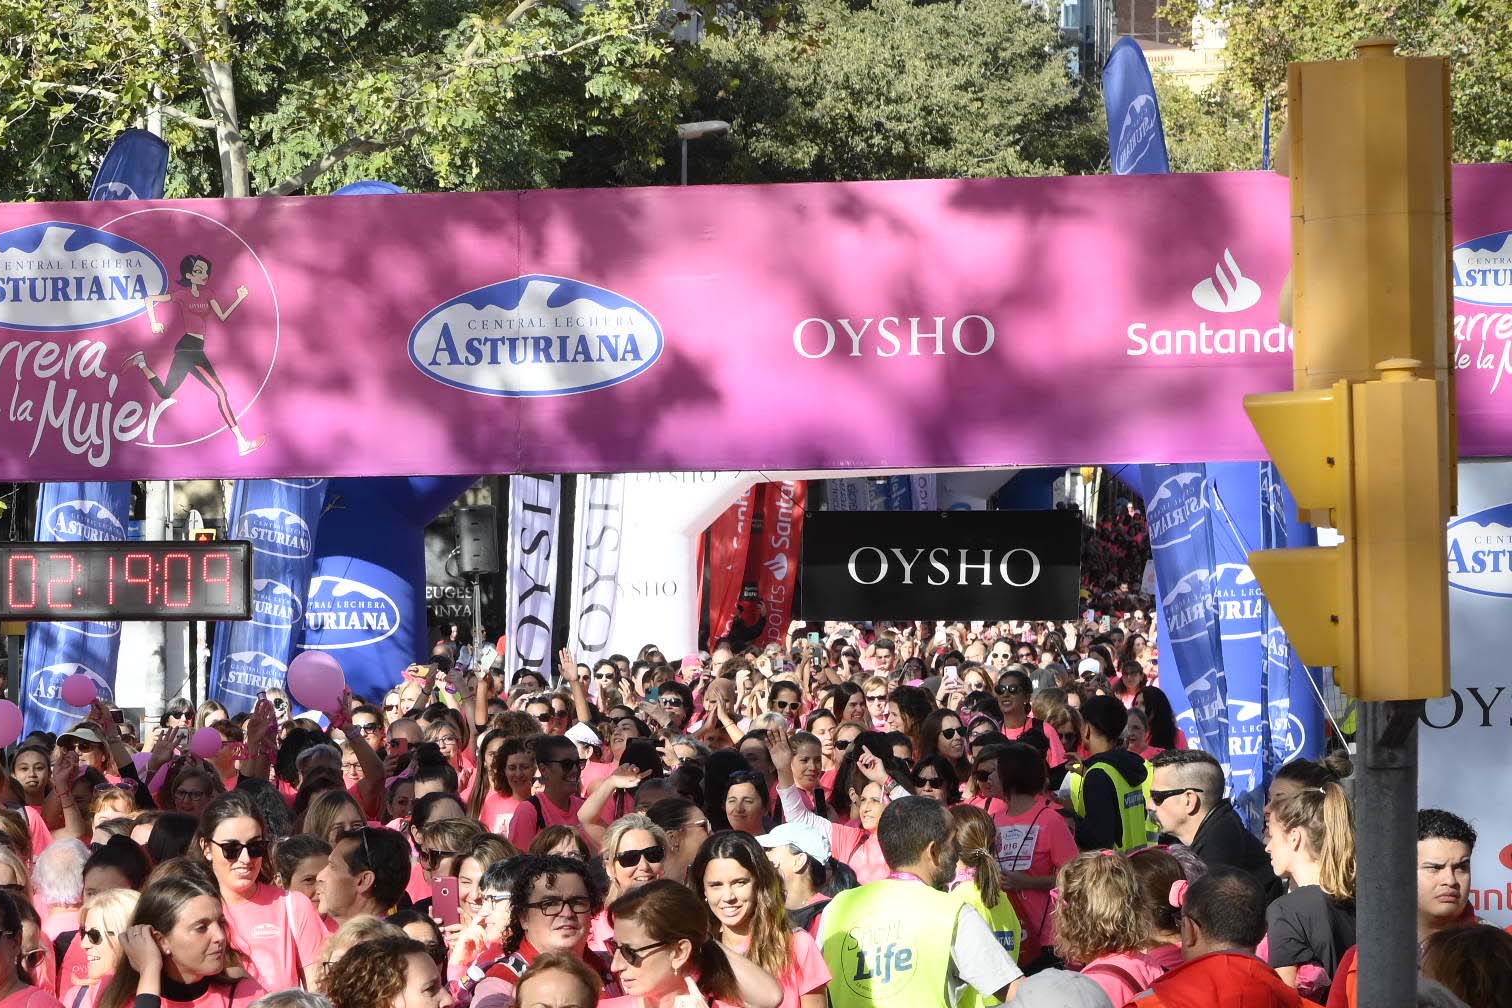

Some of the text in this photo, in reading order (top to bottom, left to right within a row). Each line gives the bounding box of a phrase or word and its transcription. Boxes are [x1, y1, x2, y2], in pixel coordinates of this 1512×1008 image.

[70, 258, 144, 270] LECHERA
[428, 323, 643, 366] ASTURIANA
[468, 316, 636, 331] CENTRAL LECHERA
[792, 315, 995, 360] OYSHO
[9, 381, 35, 423] la
[28, 374, 179, 468] Mujer
[8, 553, 232, 608] 02:19:09
[846, 545, 1041, 588] OYSHO
[336, 600, 386, 609] LECHERA
[854, 942, 914, 983] Life
